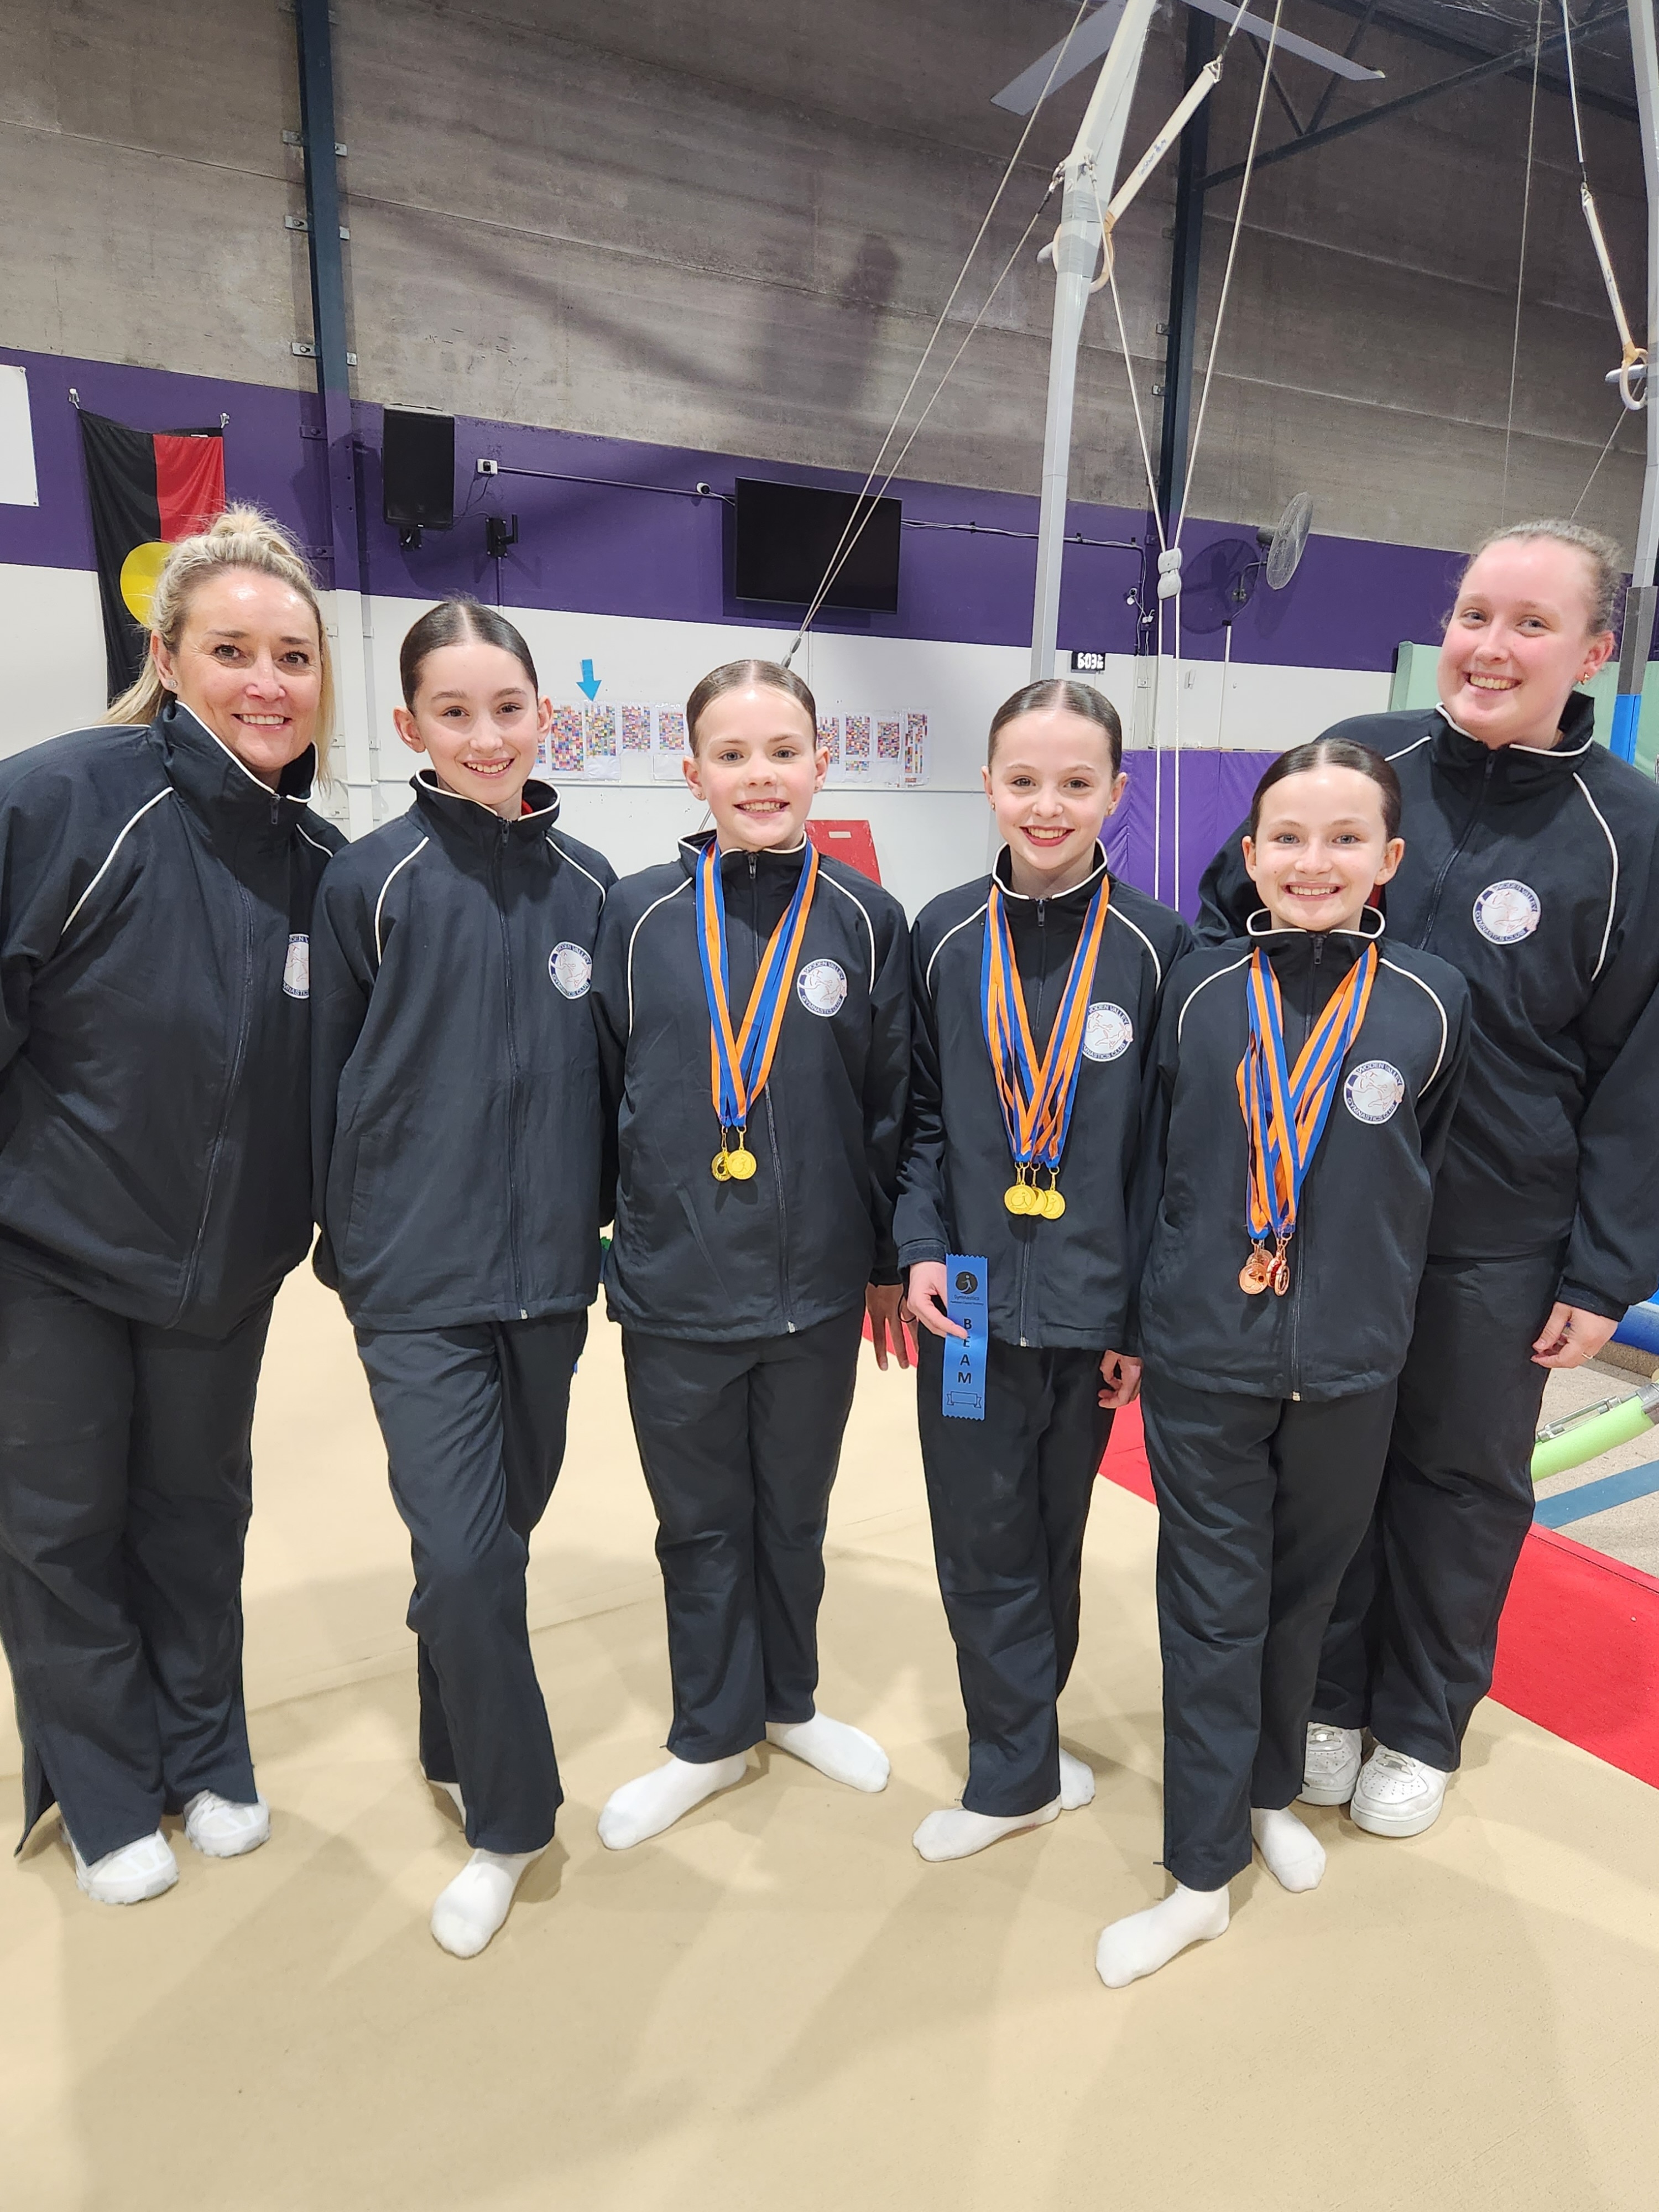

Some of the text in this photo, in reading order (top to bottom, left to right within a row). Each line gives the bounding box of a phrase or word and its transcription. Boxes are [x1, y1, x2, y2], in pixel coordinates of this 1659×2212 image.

[1109, 1005, 1130, 1025] VALLEY
[1111, 1043, 1126, 1057] CLUB
[1357, 1062, 1403, 1086] WODEN VALLEY
[1347, 1098, 1383, 1121] GYMNASTICS
[957, 1318, 972, 1385] BEAM
